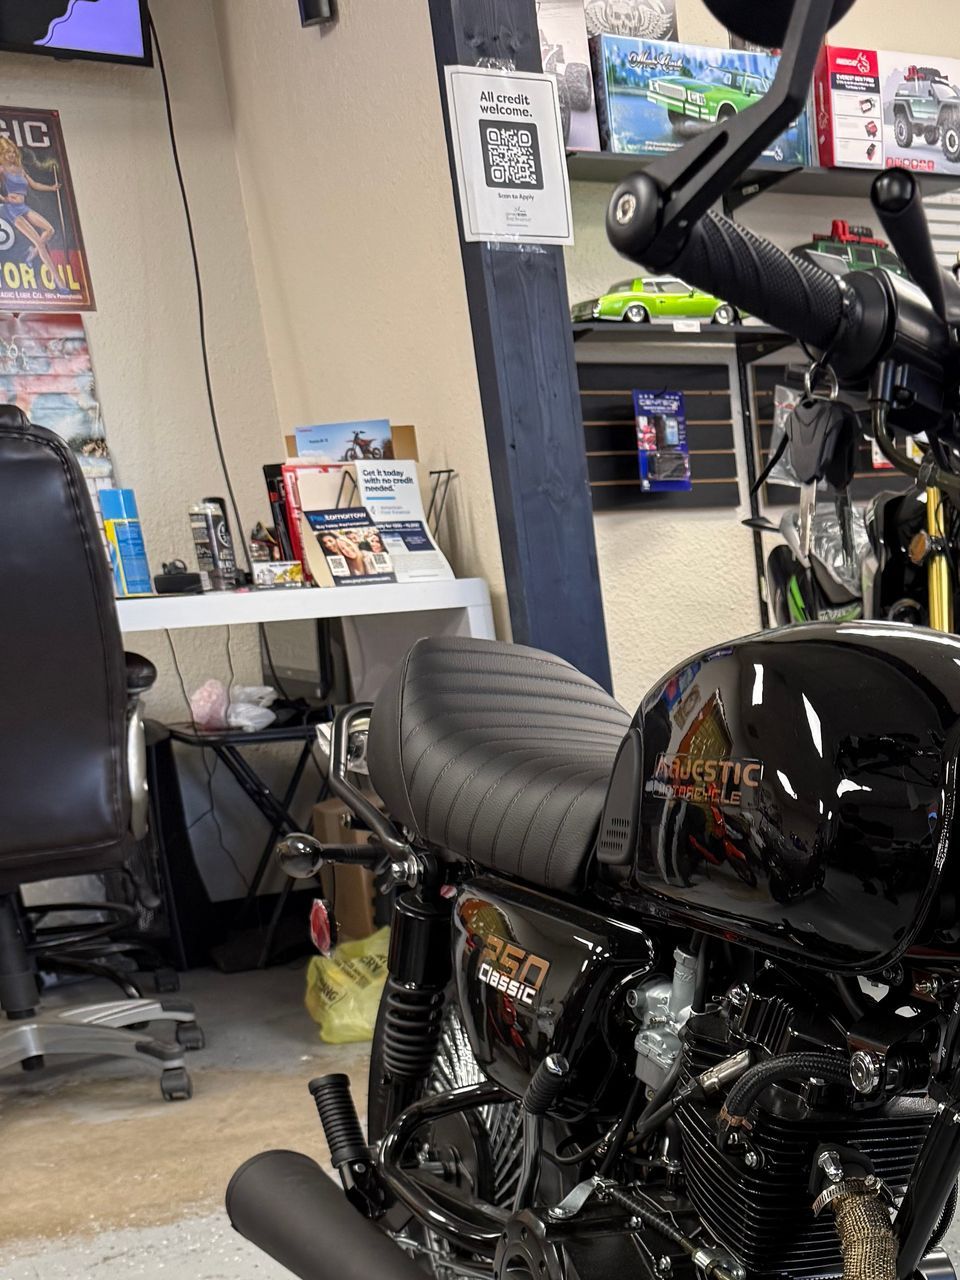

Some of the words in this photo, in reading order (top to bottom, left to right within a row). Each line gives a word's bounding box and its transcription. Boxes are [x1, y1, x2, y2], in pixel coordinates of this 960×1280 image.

[480, 91, 494, 103] All
[497, 94, 531, 106] credit
[480, 105, 533, 118] welcome.
[384, 470, 404, 479] today
[478, 962, 537, 1005] Classic
